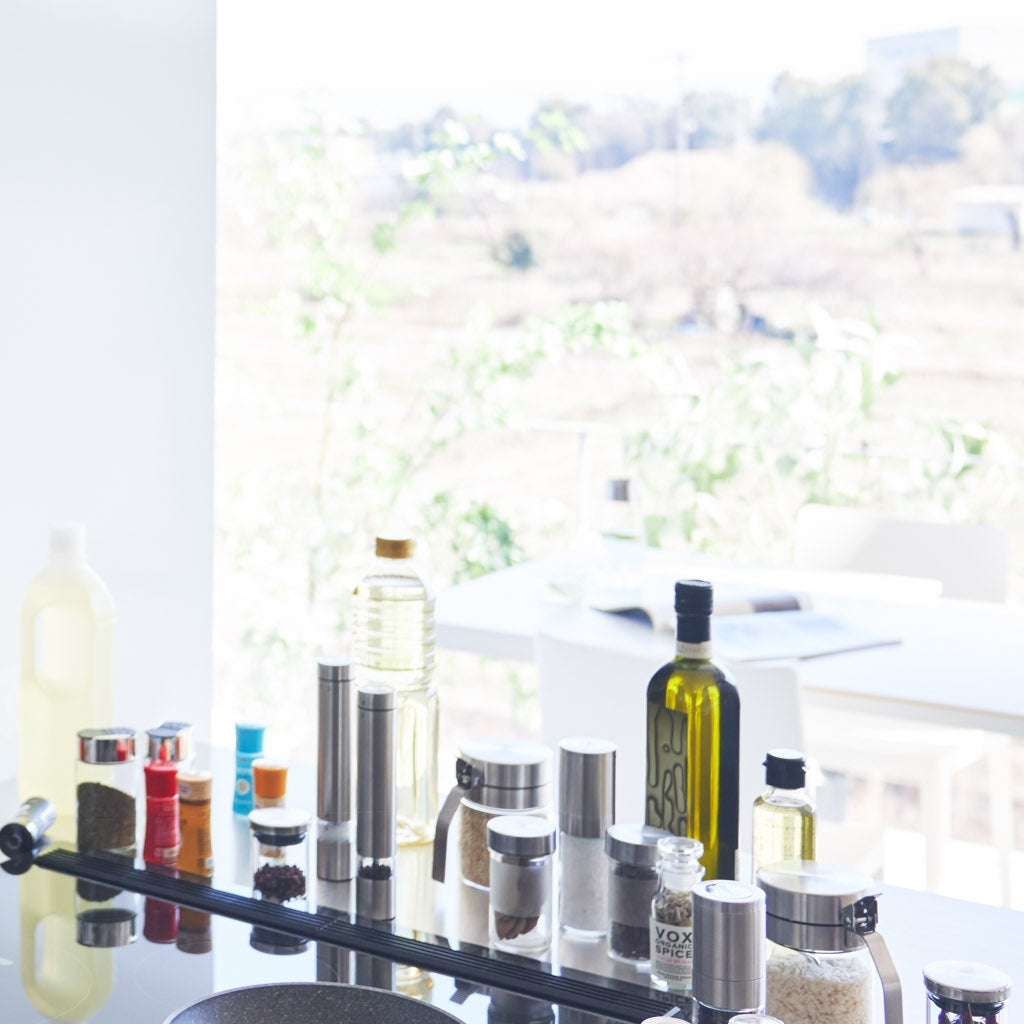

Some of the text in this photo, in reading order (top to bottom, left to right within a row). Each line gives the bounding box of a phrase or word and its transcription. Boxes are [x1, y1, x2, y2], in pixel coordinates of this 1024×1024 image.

[655, 926, 692, 943] VOX
[655, 938, 693, 951] ORGANIC
[655, 945, 693, 959] SPICE
